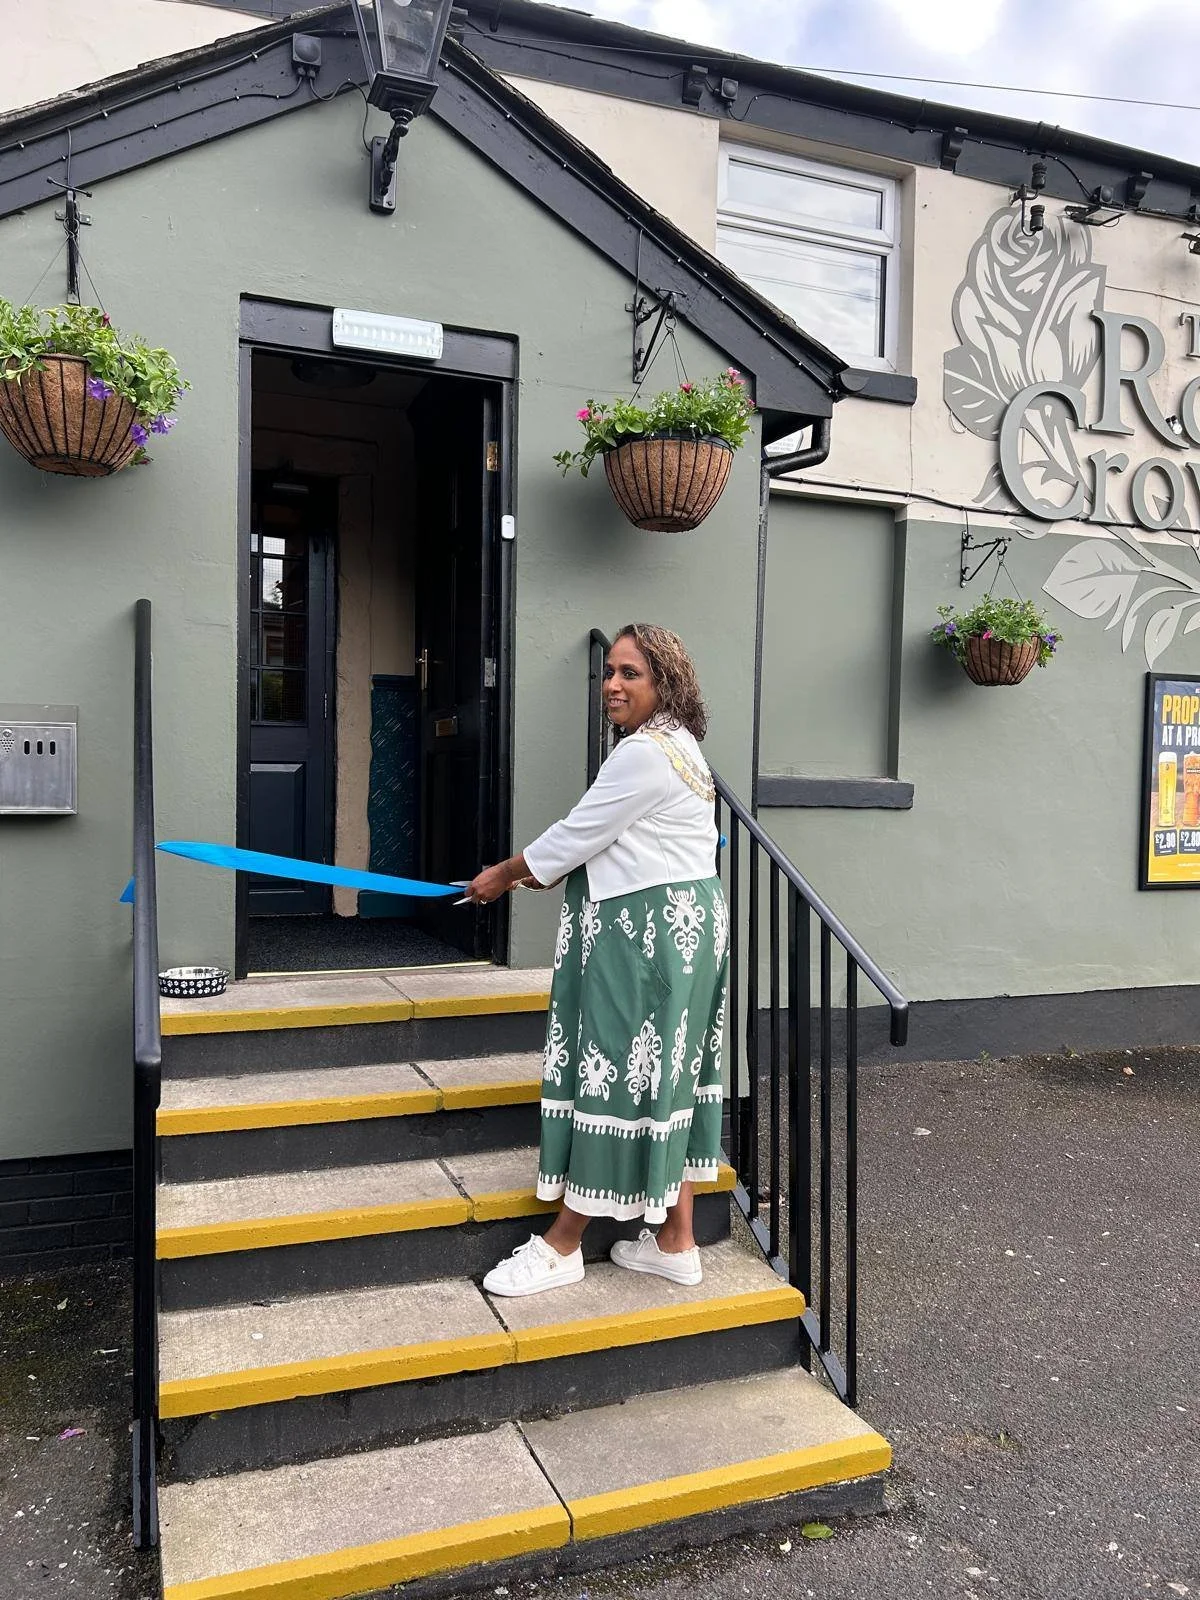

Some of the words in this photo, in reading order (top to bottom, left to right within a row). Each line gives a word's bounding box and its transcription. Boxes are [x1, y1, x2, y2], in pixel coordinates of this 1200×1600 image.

[1162, 694, 1200, 725] PROP
[1162, 725, 1174, 746] AT
[1176, 725, 1183, 746] A
